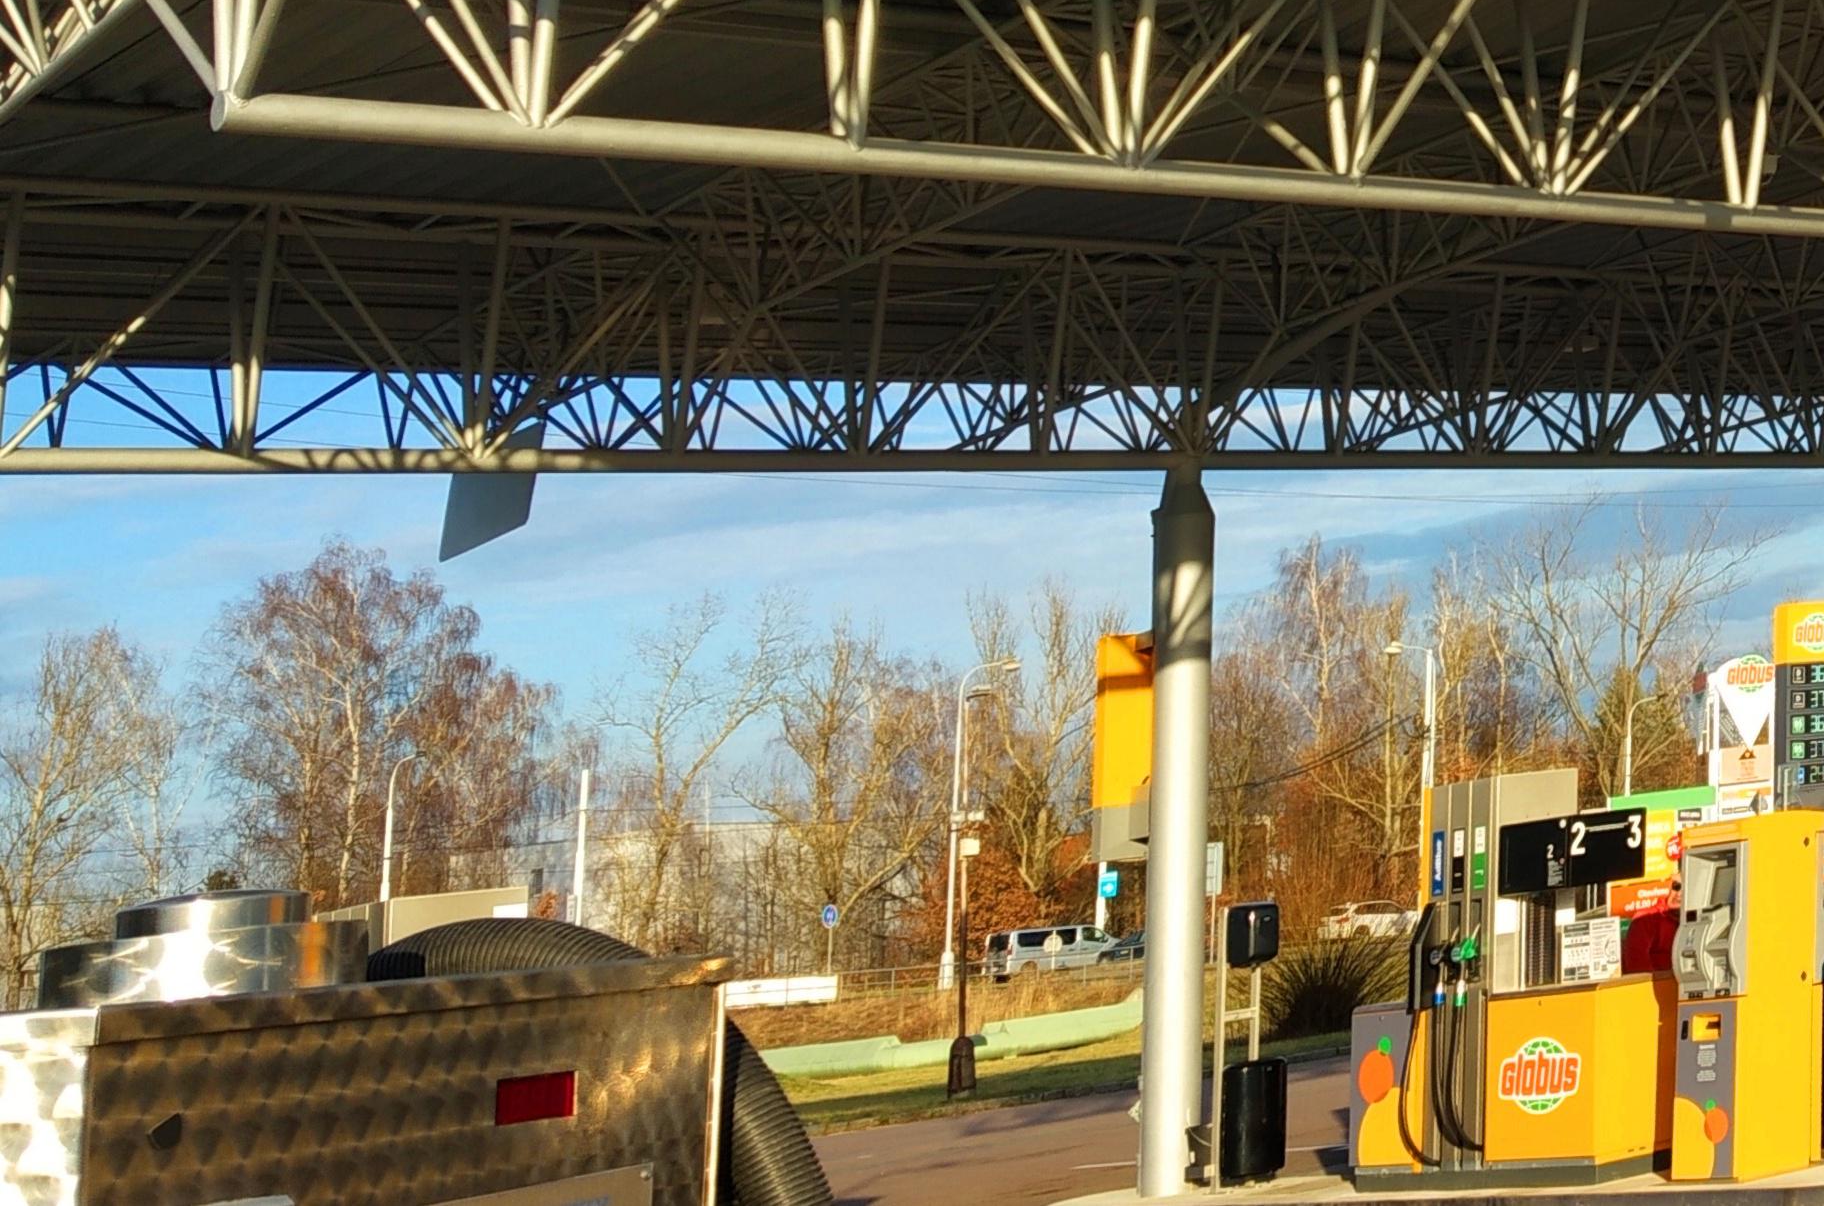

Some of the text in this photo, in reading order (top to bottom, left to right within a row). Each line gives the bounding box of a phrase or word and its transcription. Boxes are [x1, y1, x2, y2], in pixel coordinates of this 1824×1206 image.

[1726, 660, 1775, 686] Globus
[1546, 844, 1554, 859] 2
[1570, 821, 1586, 856] 2
[1627, 814, 1642, 849] 3
[1500, 1049, 1579, 1097] Globus
